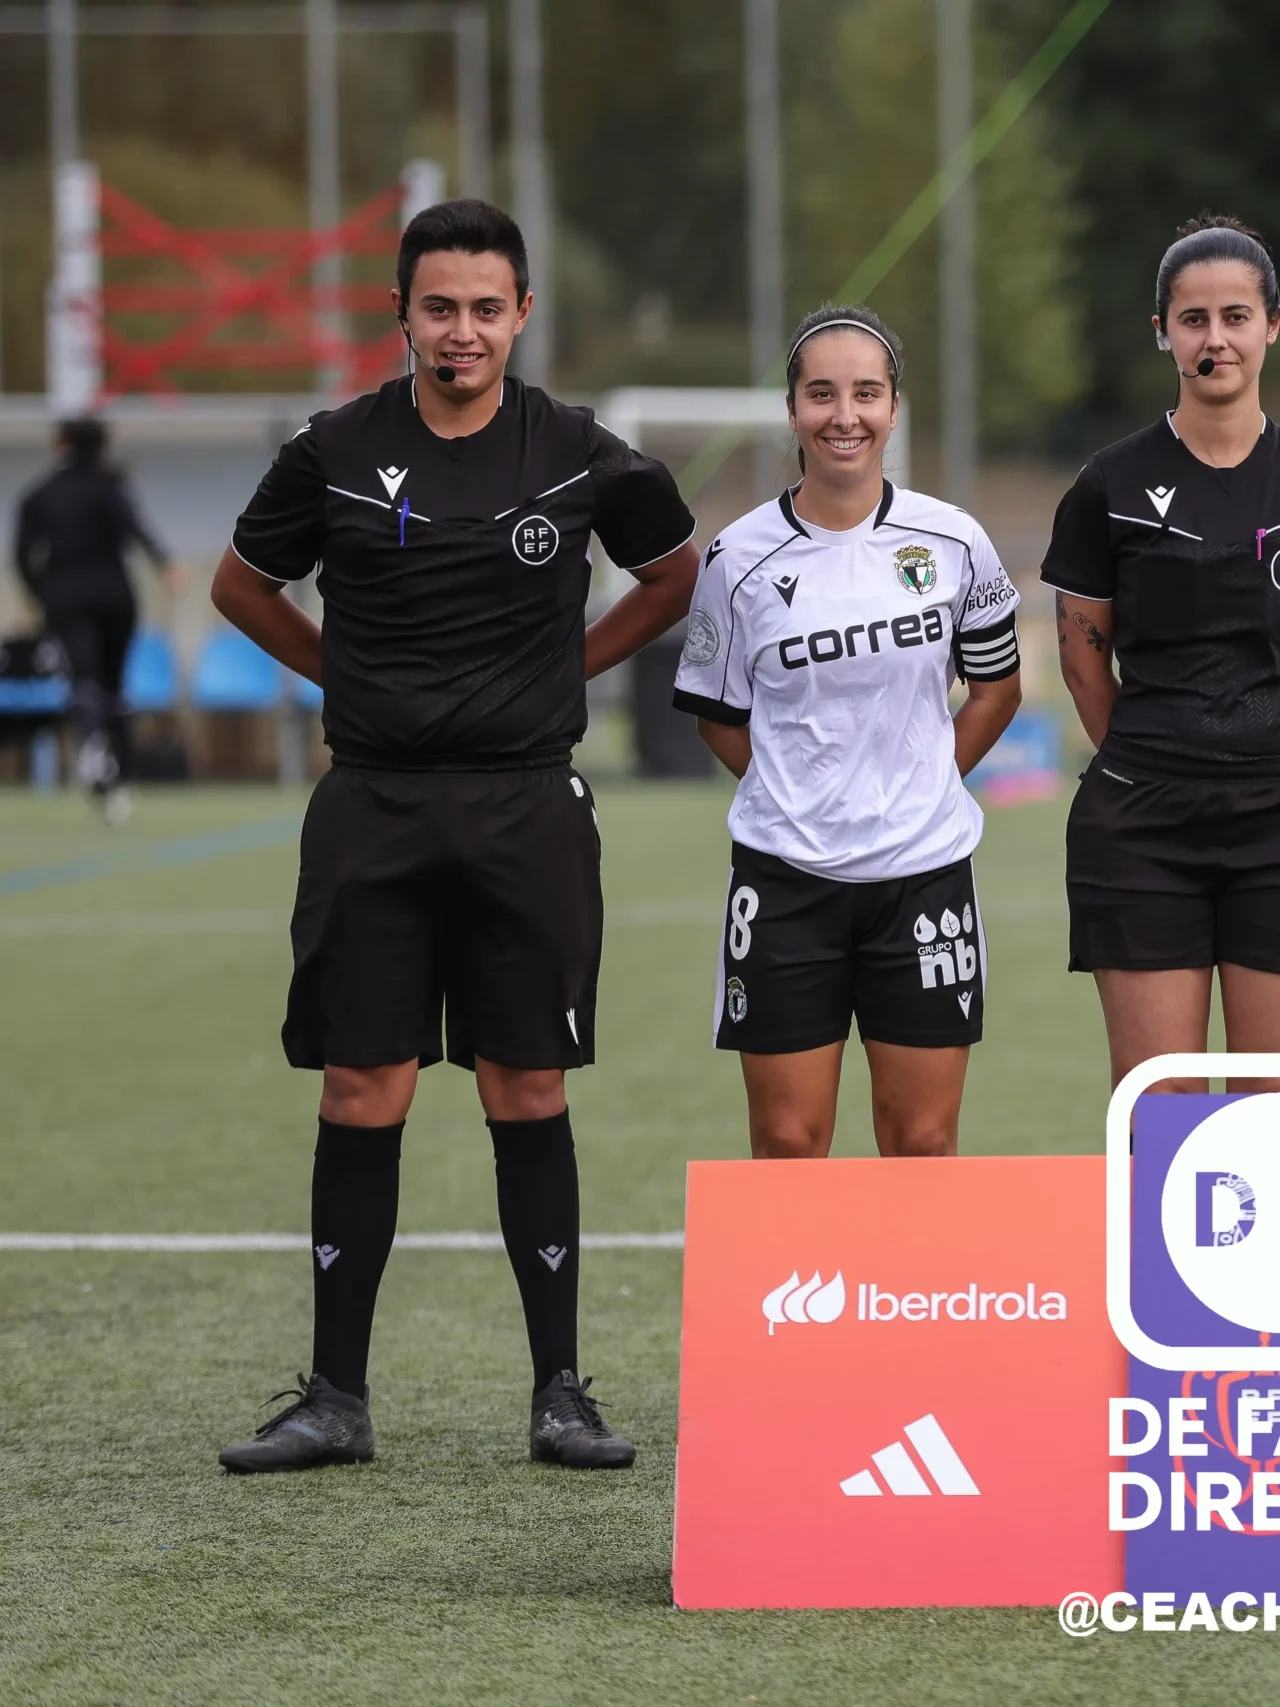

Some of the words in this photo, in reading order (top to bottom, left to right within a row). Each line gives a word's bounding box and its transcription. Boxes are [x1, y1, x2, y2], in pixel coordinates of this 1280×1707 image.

[523, 527, 549, 540] RF
[524, 541, 549, 554] EF
[969, 580, 995, 599] CAJA
[778, 608, 944, 671] correa
[729, 885, 759, 960] 8
[917, 941, 952, 956] GRUPO
[919, 938, 977, 989] nb
[857, 1282, 1068, 1321] Iberdrola
